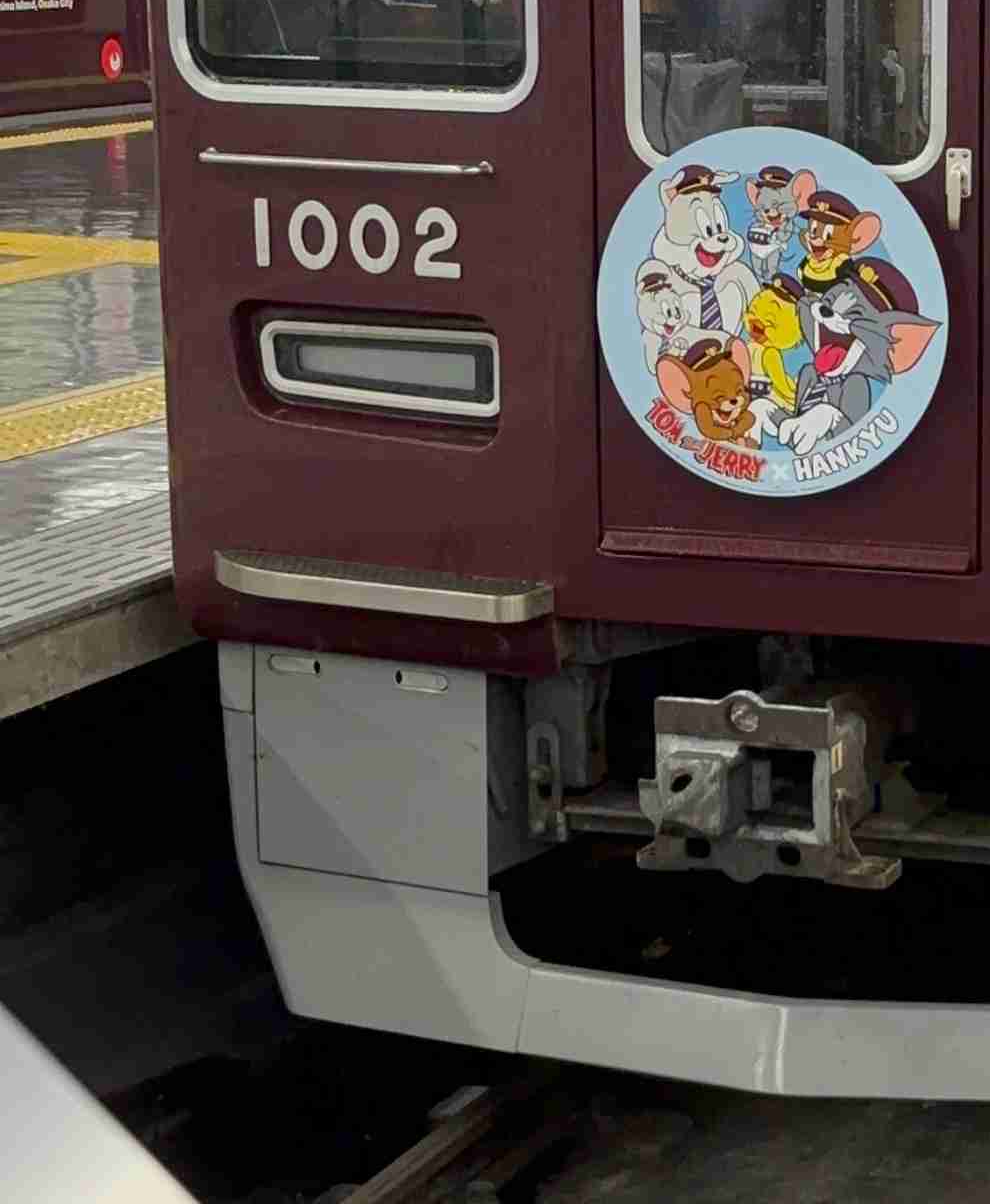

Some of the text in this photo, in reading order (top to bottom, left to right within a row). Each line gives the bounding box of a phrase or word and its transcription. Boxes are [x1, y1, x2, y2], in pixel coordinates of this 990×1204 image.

[254, 197, 461, 279] 1002
[646, 399, 684, 445] TOM
[695, 442, 768, 482] JERRY
[793, 407, 898, 482] HANKYU
